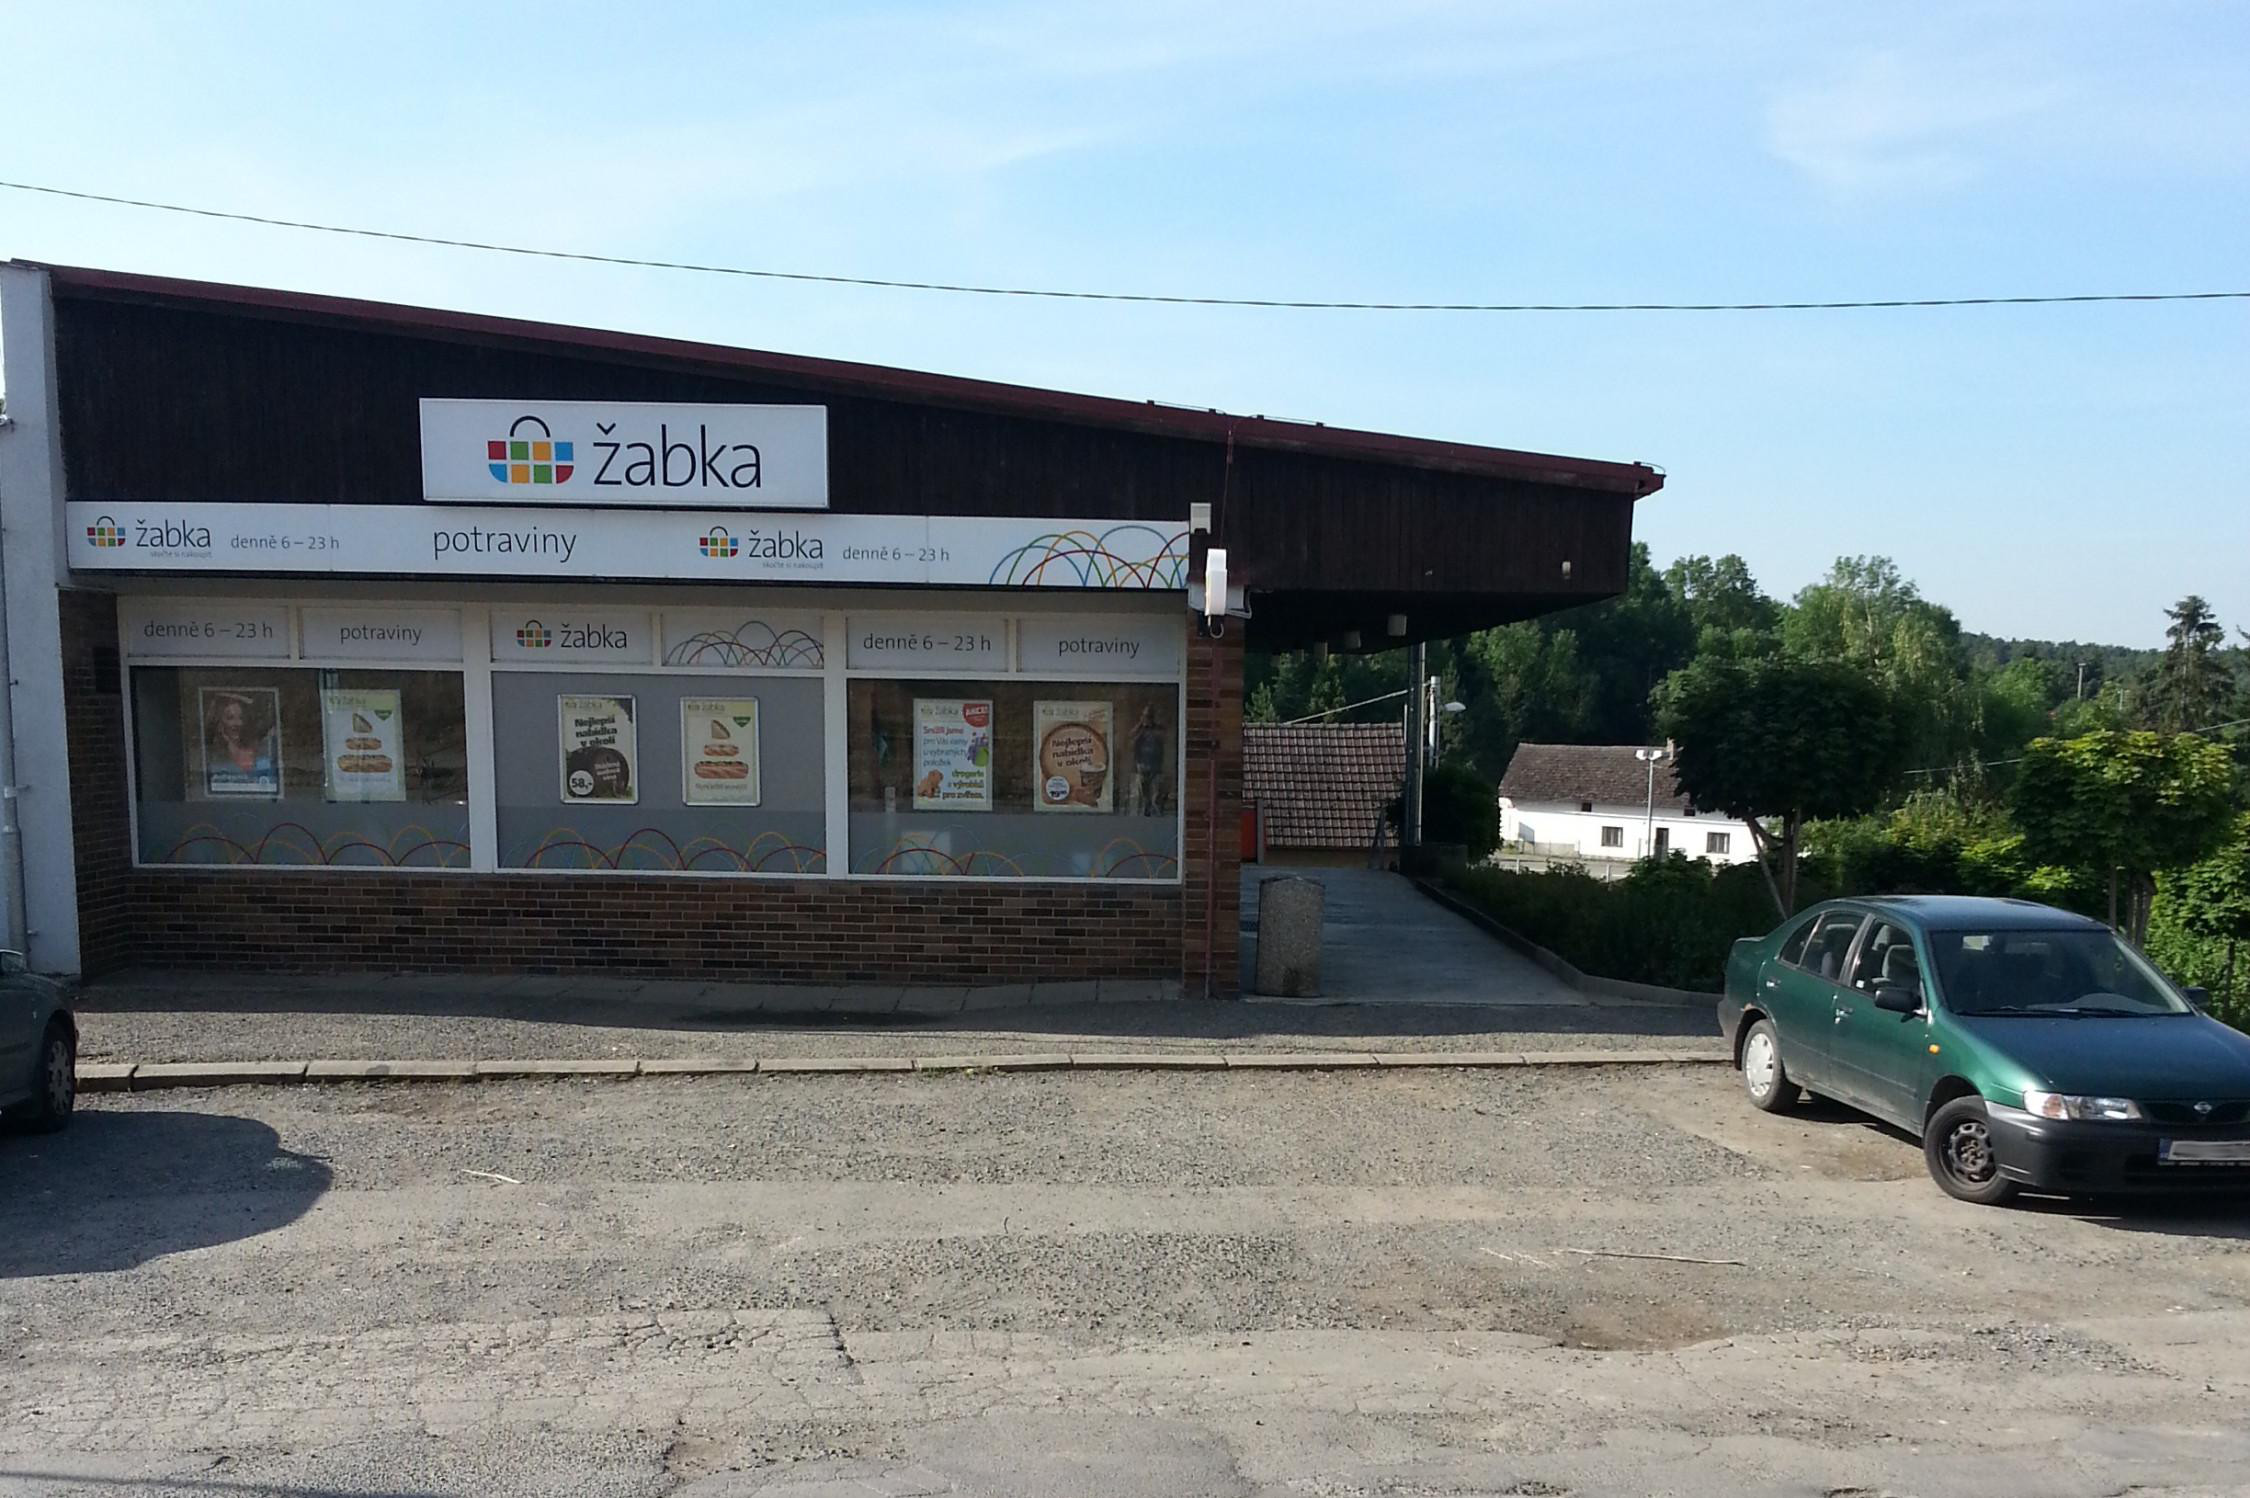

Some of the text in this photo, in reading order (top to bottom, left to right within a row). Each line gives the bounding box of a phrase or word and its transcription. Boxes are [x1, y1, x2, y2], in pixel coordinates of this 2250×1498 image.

[593, 422, 762, 489] žabka
[136, 519, 212, 548] žabka
[230, 534, 278, 549] denně
[280, 536, 291, 550] 6
[307, 536, 327, 550] 23
[330, 536, 340, 550] h
[433, 526, 577, 561] potraviny
[747, 529, 824, 559] žabka
[842, 545, 889, 561] denně
[892, 547, 902, 561] 6
[918, 547, 937, 562] 23
[940, 547, 950, 562] h
[143, 621, 200, 637] denně
[203, 622, 216, 638] 6
[234, 623, 257, 639] 23
[261, 622, 273, 639] h
[340, 625, 423, 646] potraviny
[560, 622, 628, 649] žabka
[863, 633, 918, 650] denně
[922, 635, 934, 651] 6
[953, 635, 976, 652] 23
[980, 634, 991, 651] h
[1058, 637, 1140, 660] potraviny
[575, 726, 618, 738] nabídka
[1052, 746, 1094, 759] nabídka
[571, 778, 593, 790] 58,-
